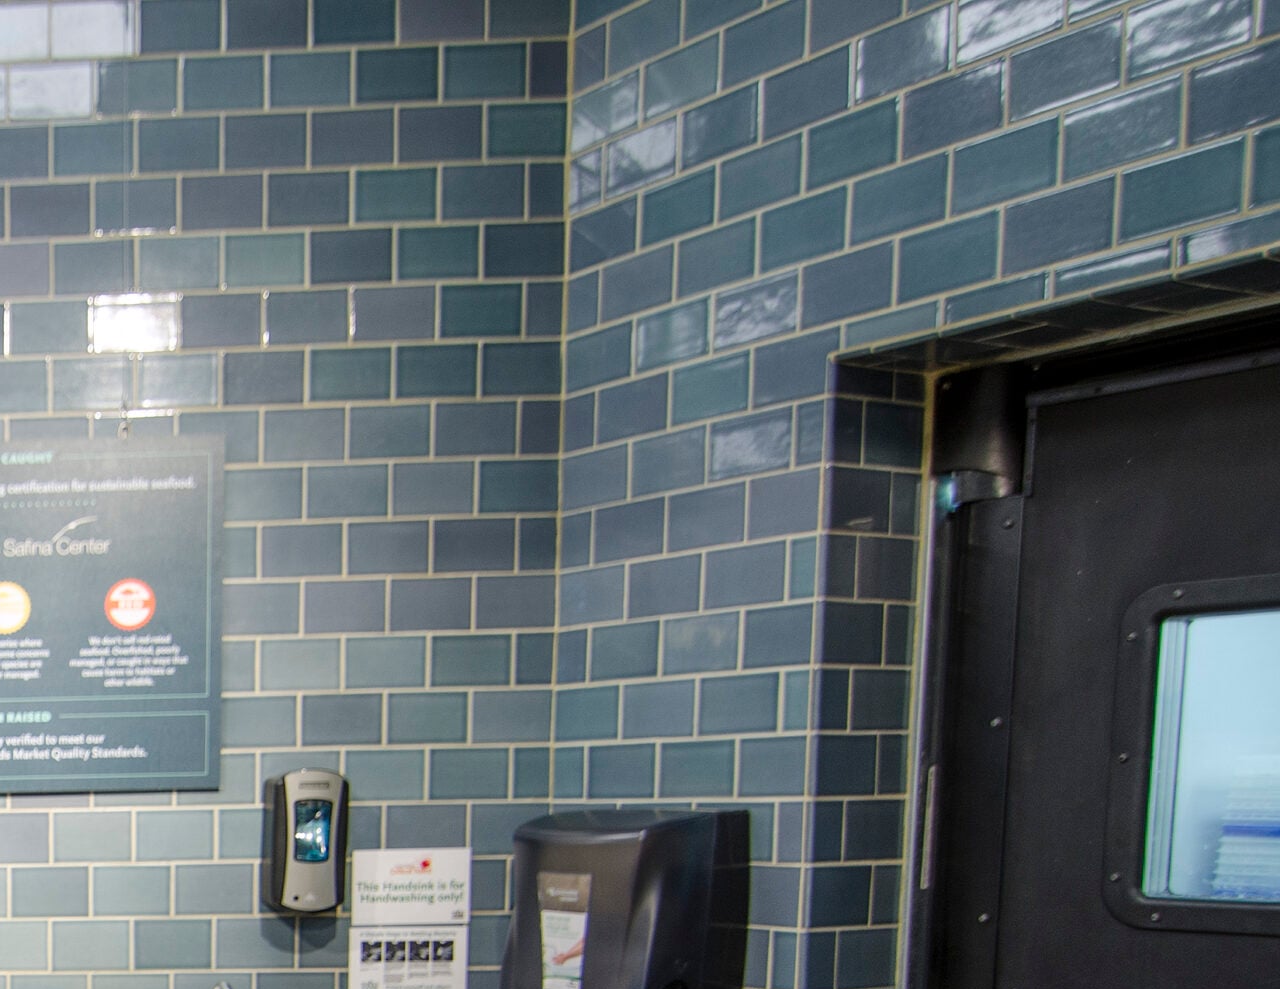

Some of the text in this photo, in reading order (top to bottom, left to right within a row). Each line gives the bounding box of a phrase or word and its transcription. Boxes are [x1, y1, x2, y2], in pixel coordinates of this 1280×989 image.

[1, 451, 53, 465] CAUGHT
[7, 478, 70, 496] certification
[71, 477, 87, 493] for
[88, 476, 149, 492] sustainable
[3, 537, 54, 558] Safina
[56, 535, 112, 556] Center
[6, 711, 53, 724] RAISED
[5, 733, 45, 747] verified
[45, 734, 58, 746] to
[58, 733, 85, 745] meet
[85, 734, 106, 745] our
[12, 747, 51, 761] Market
[51, 746, 91, 762] Quality
[91, 744, 149, 759] Standards.
[357, 879, 466, 893] This Handsink is for
[360, 891, 465, 906] Handwashing only!
